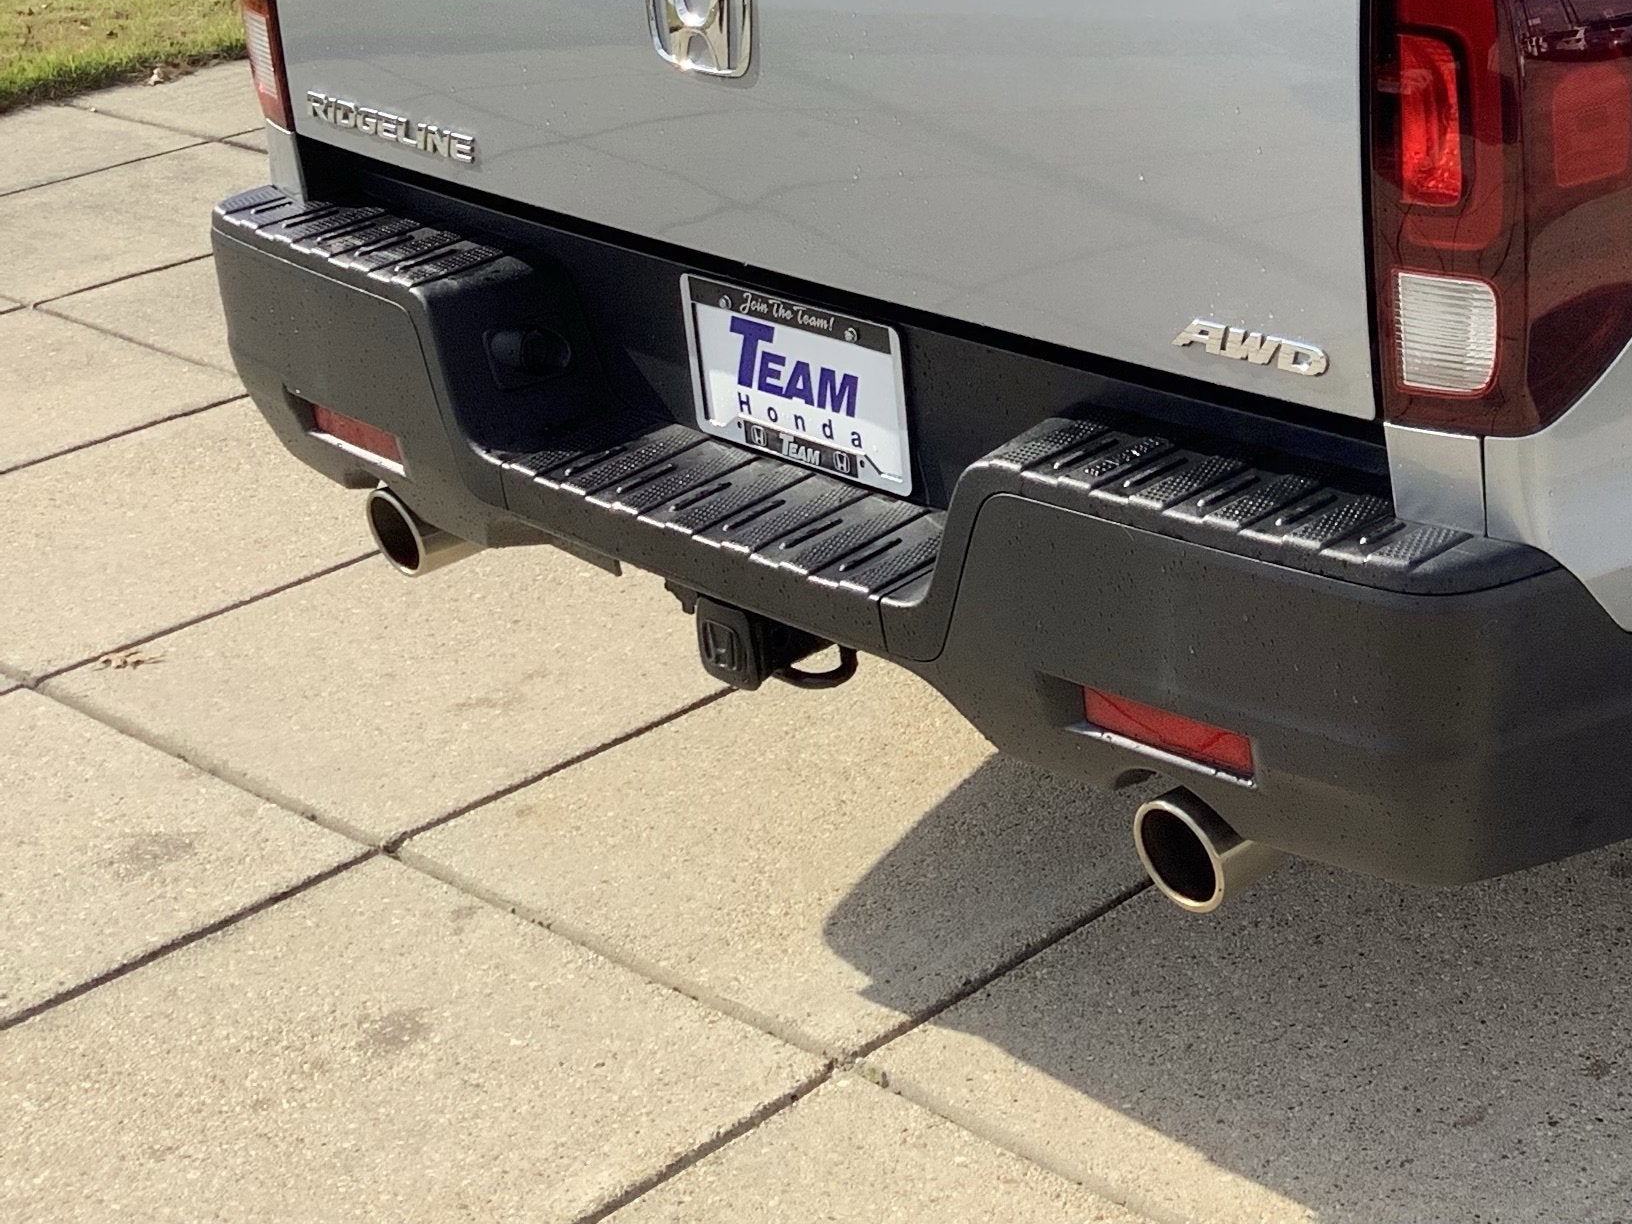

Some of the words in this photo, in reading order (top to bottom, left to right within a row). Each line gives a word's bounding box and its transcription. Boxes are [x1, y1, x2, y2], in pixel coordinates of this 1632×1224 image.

[307, 90, 475, 164] RIDGELINE
[739, 292, 768, 315] Join
[768, 298, 794, 321] The
[793, 305, 835, 331] Team!
[729, 315, 859, 419] TEAM
[1171, 318, 1330, 377] AWD
[737, 391, 862, 450] Honda
[778, 432, 821, 467] TEAM
